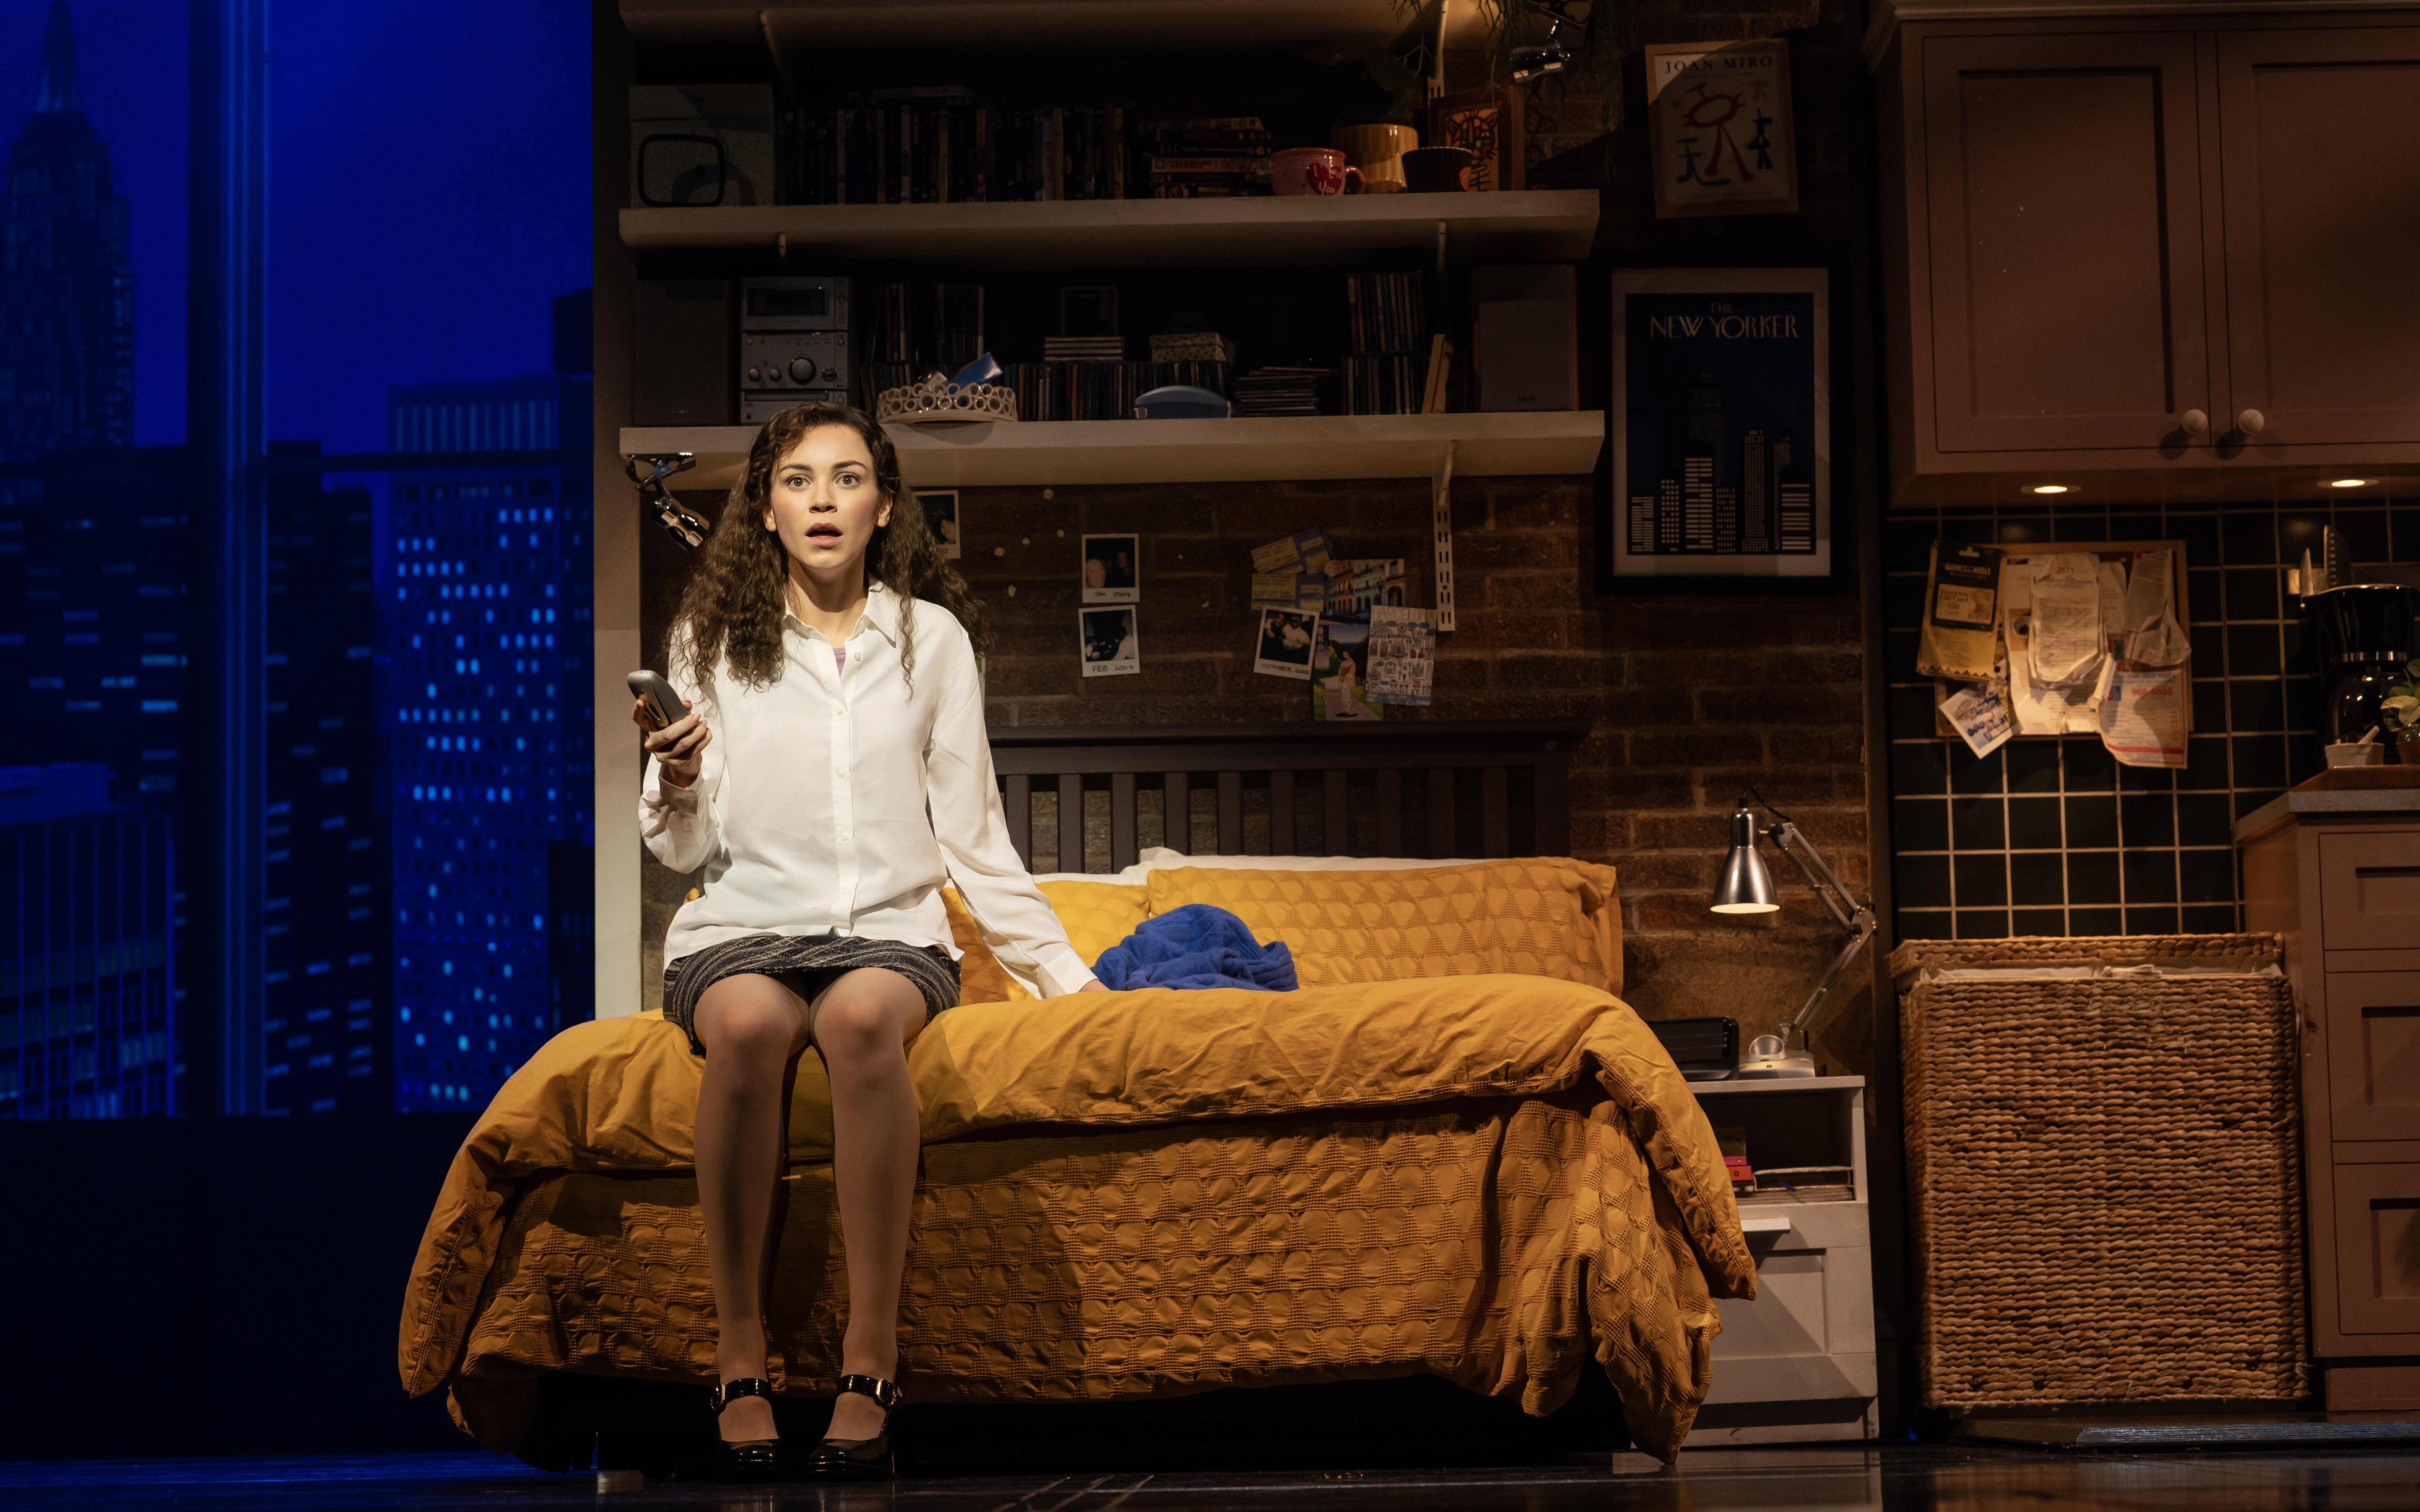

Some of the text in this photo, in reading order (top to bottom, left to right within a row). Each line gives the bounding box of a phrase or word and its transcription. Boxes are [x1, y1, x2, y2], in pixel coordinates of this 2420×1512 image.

[1665, 59, 1713, 74] JOAN
[1313, 164, 1318, 177] I
[1319, 180, 1335, 195] You
[1709, 302, 1734, 314] THE
[1649, 315, 1800, 340] NEW YORKER
[1092, 664, 1108, 673] FEB
[1261, 663, 1292, 672] OCTOBER
